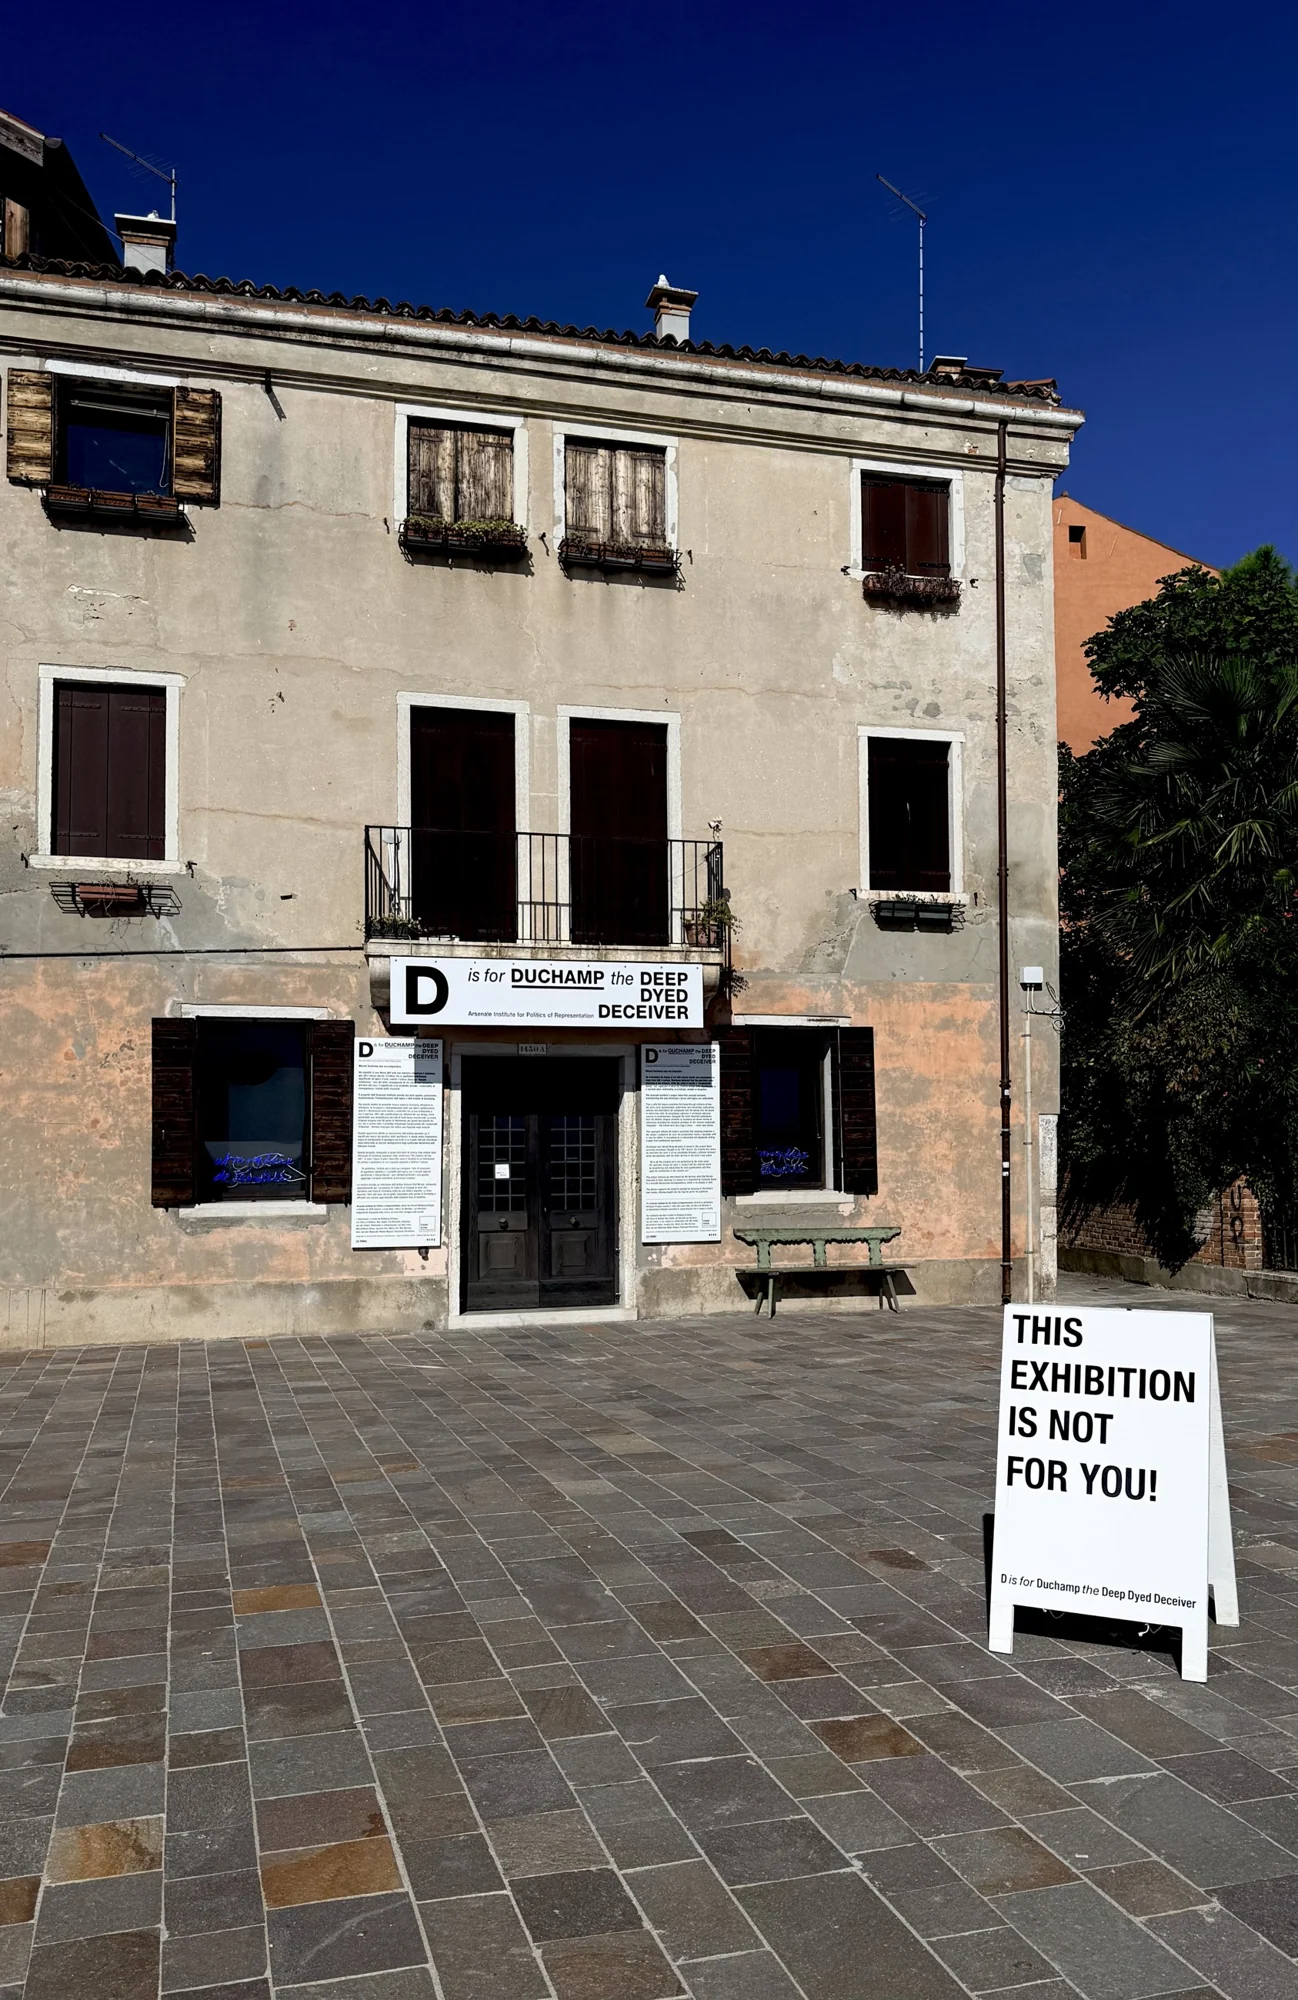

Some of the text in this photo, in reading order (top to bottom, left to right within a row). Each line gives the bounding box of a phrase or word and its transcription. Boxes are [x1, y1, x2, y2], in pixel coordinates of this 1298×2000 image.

[405, 965, 689, 1015] D is for DUCHAMP the DEEP
[640, 988, 689, 1003] DYED
[598, 1004, 689, 1020] DECEIVER
[358, 1041, 374, 1058] D
[645, 1048, 659, 1064] D
[1013, 1315, 1082, 1347] THIS
[1011, 1360, 1195, 1402] EXHIBITION
[1009, 1406, 1113, 1444] IS NOT
[1007, 1456, 1156, 1501] FOR YOU!
[1000, 1573, 1197, 1609] D is for Duchamp the Deep Dyed Deceiver
